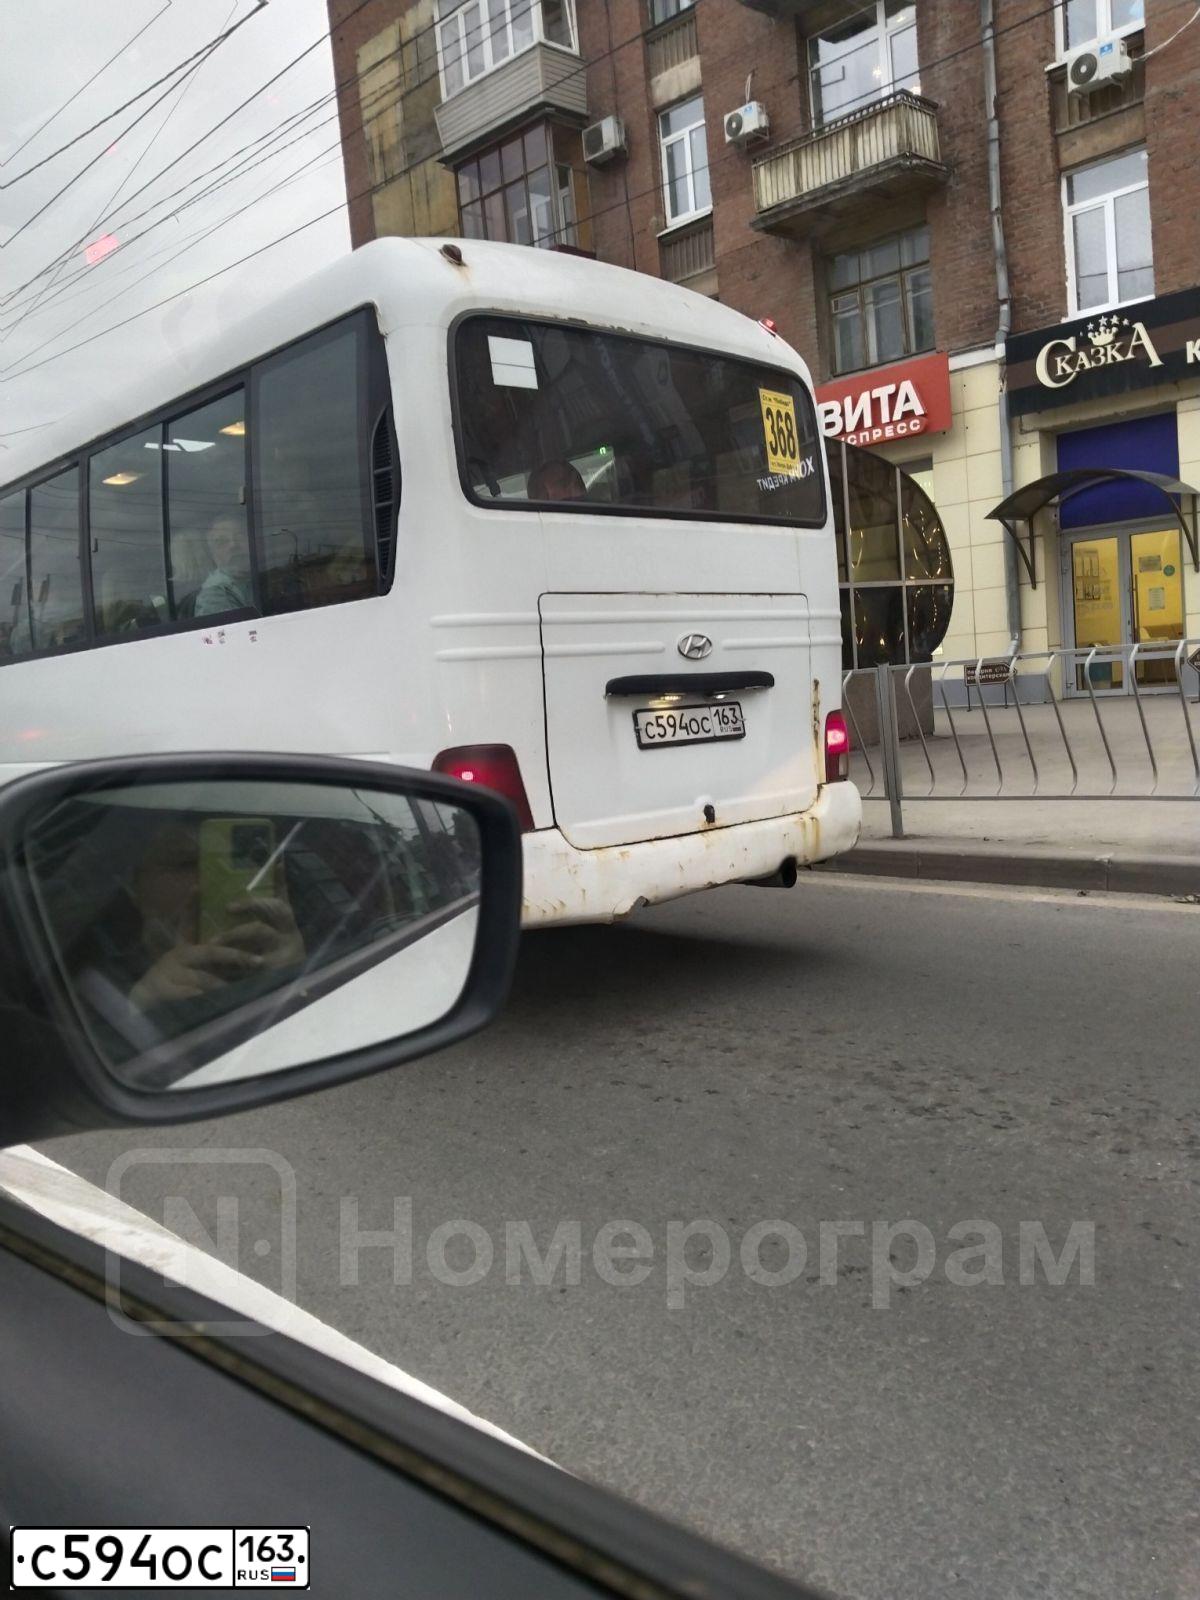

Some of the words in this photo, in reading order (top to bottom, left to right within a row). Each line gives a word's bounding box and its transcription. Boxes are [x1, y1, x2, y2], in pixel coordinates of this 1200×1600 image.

[1035, 321, 1165, 389] СКАЗКА
[765, 406, 797, 460] 368
[817, 379, 926, 438] ВИТА
[841, 419, 922, 445] СПРЕСС
[645, 712, 711, 739] С594ОС
[713, 707, 738, 725] 163
